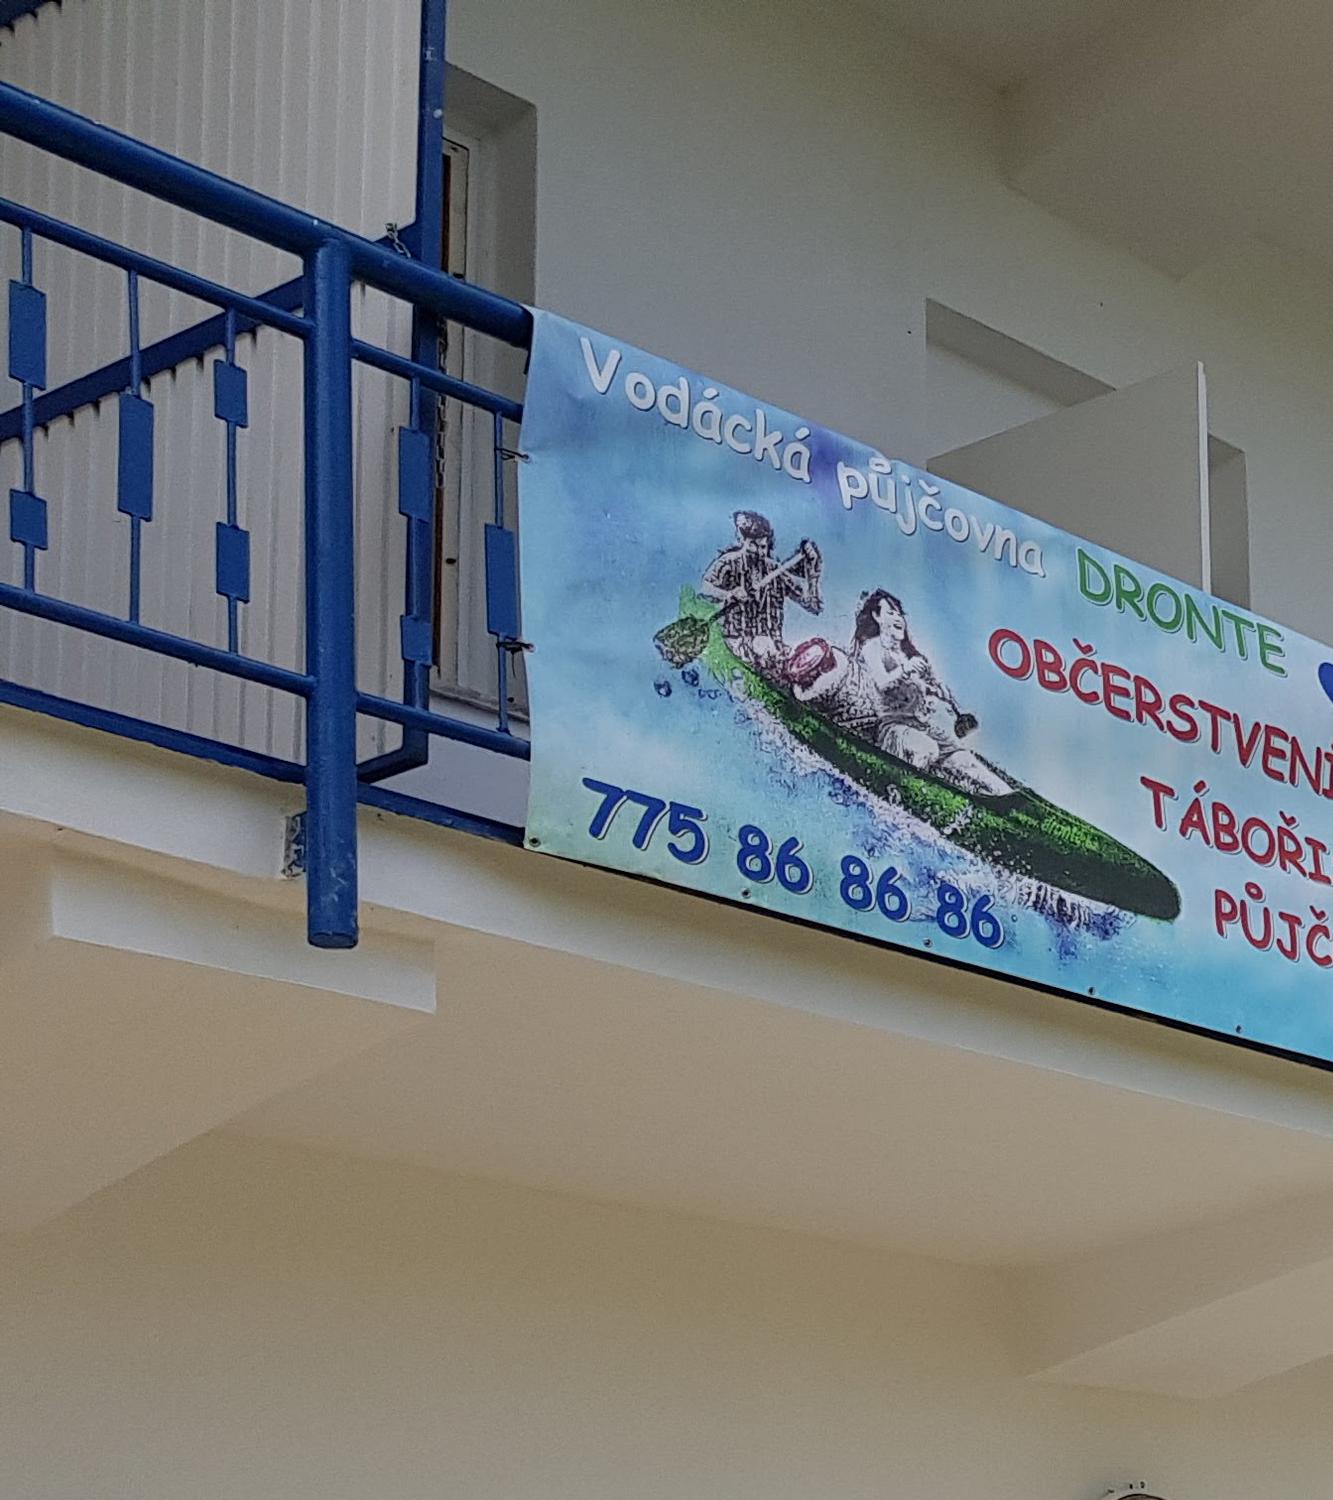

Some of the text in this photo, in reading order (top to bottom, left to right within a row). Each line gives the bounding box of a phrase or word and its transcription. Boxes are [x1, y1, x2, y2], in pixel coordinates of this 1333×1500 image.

[580, 336, 1287, 676] Vodácká půjčovna DRONTE
[582, 777, 1004, 949] 775 86 86 86
